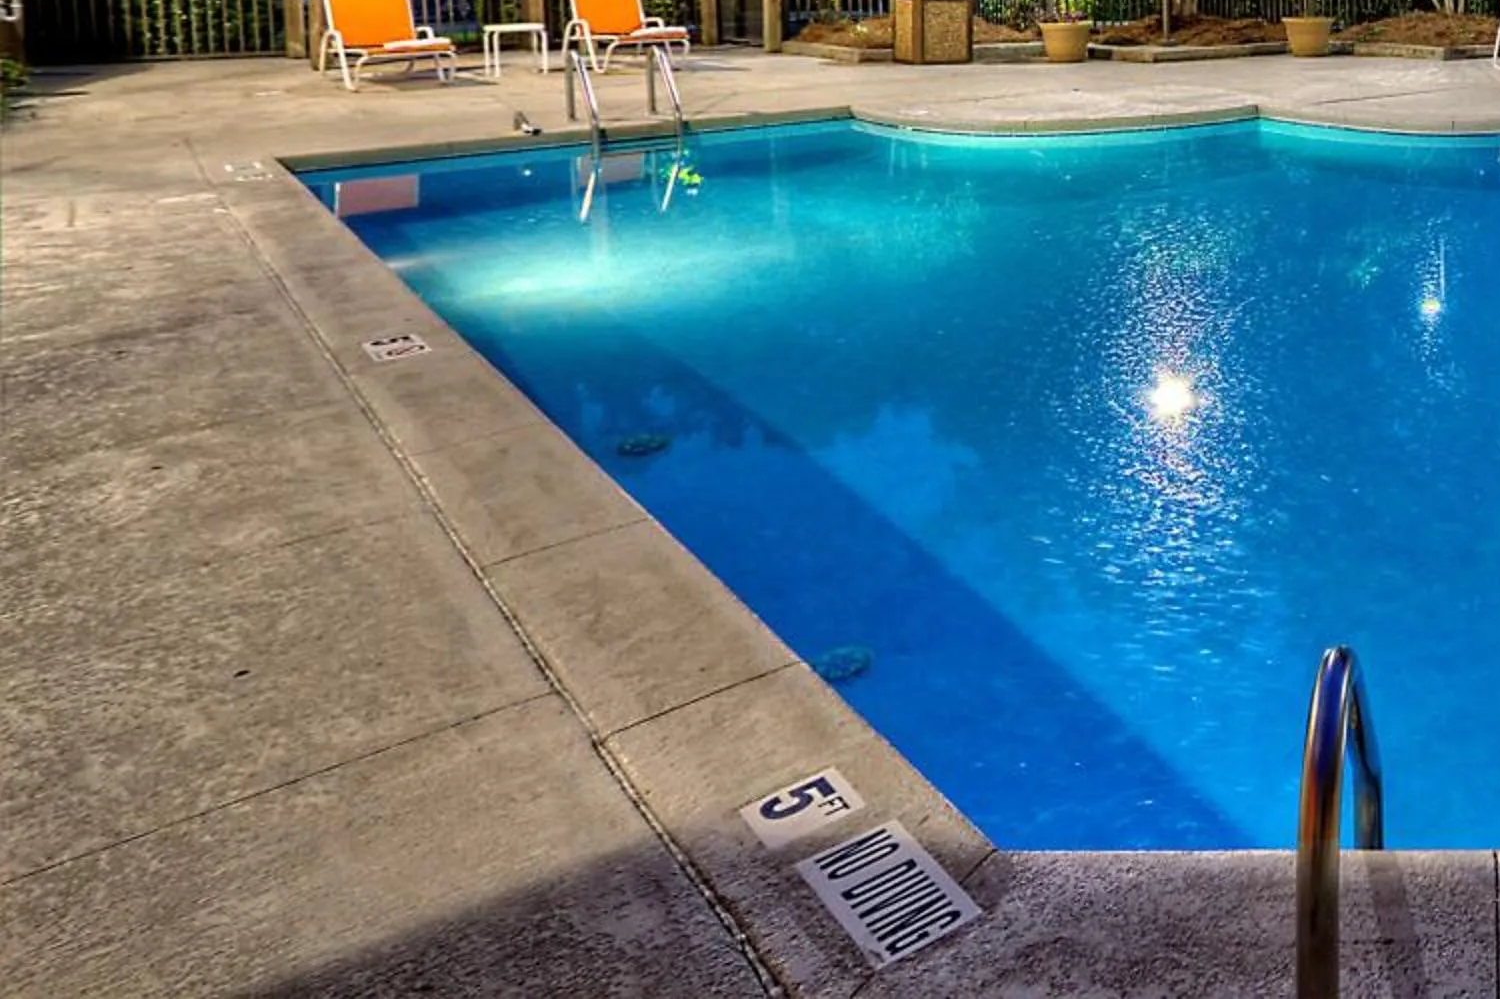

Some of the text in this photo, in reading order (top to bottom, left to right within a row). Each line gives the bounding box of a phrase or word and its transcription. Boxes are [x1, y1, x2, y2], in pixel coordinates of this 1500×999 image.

[760, 776, 851, 820] 5 FT
[814, 828, 962, 956] NO DIVING
